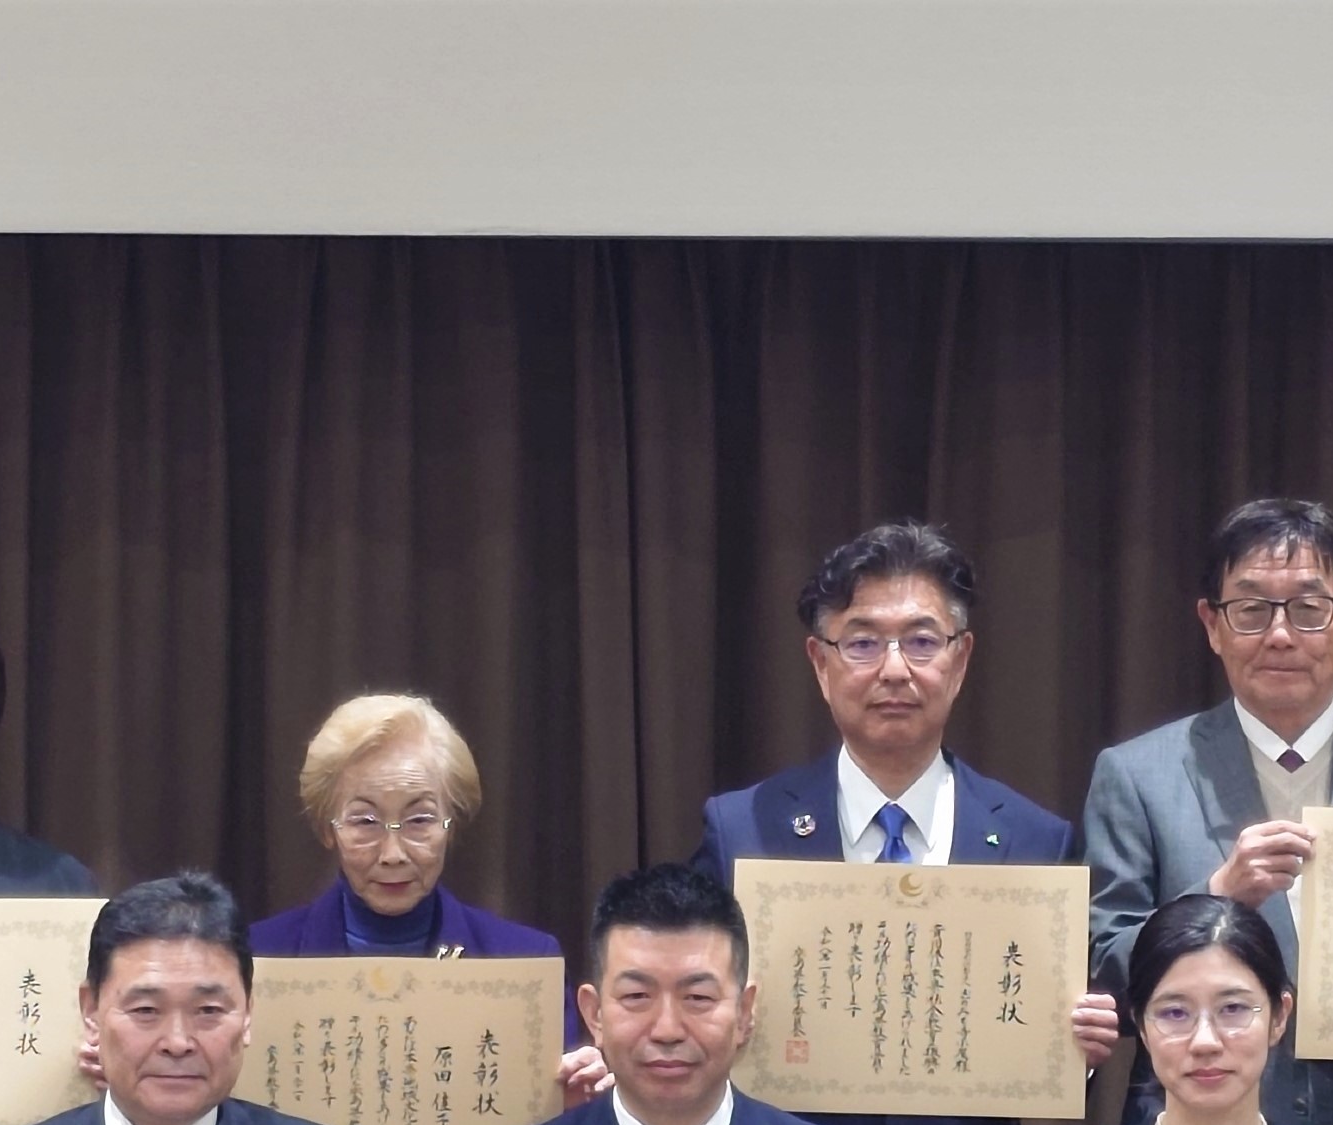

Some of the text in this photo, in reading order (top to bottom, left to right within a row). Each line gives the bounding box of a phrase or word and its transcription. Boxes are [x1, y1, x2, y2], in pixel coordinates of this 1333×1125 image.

[14, 967, 43, 1056] 表彰状
[995, 940, 1028, 1026] 表彰状
[471, 1028, 504, 1116] 表彰状
